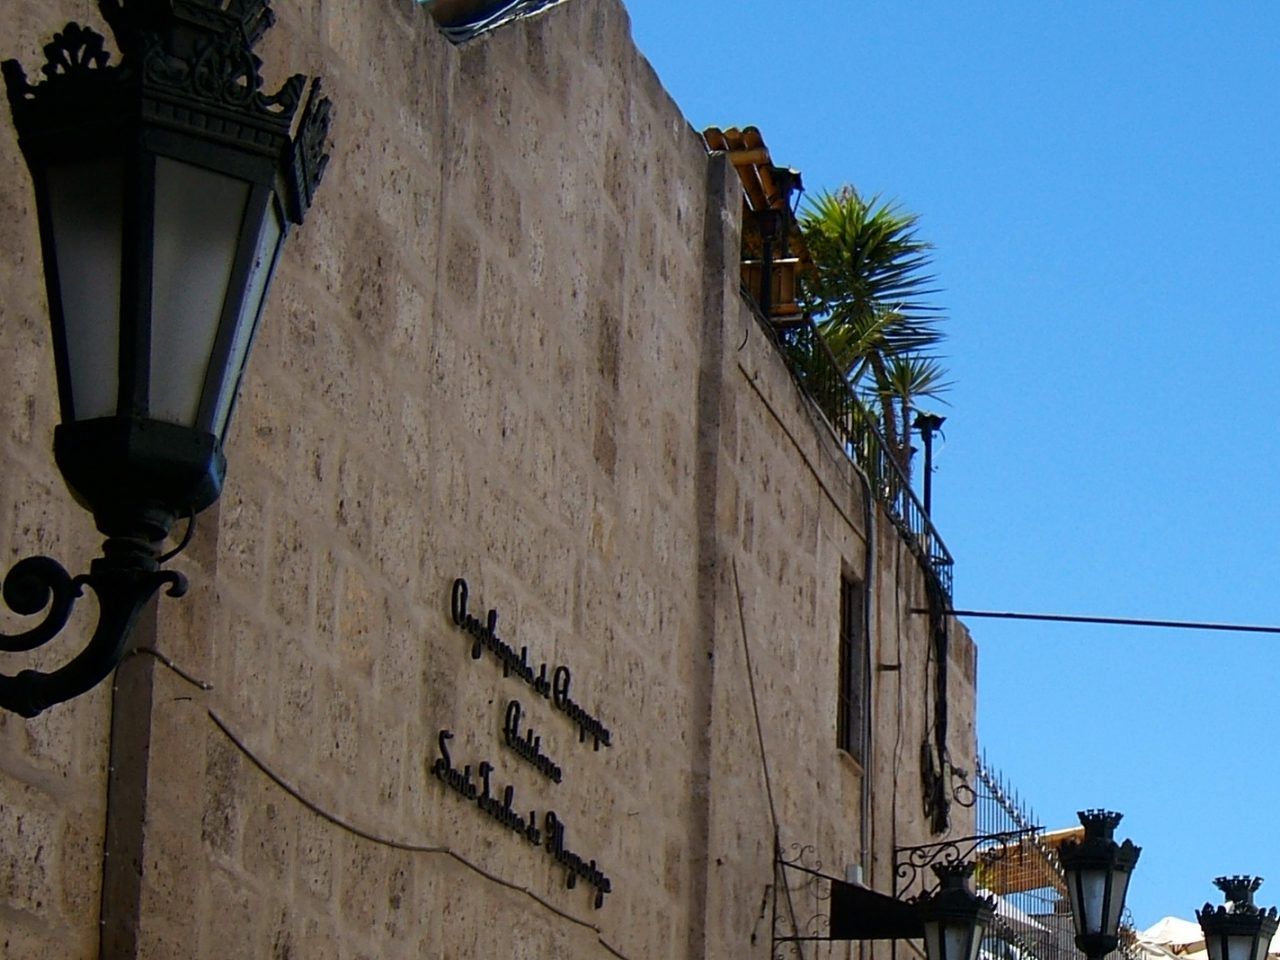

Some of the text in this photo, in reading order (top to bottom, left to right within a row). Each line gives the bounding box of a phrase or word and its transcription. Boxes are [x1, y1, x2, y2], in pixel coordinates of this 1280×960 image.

[534, 663, 551, 700] de
[553, 666, 611, 752] Arequipa
[526, 811, 542, 846] de
